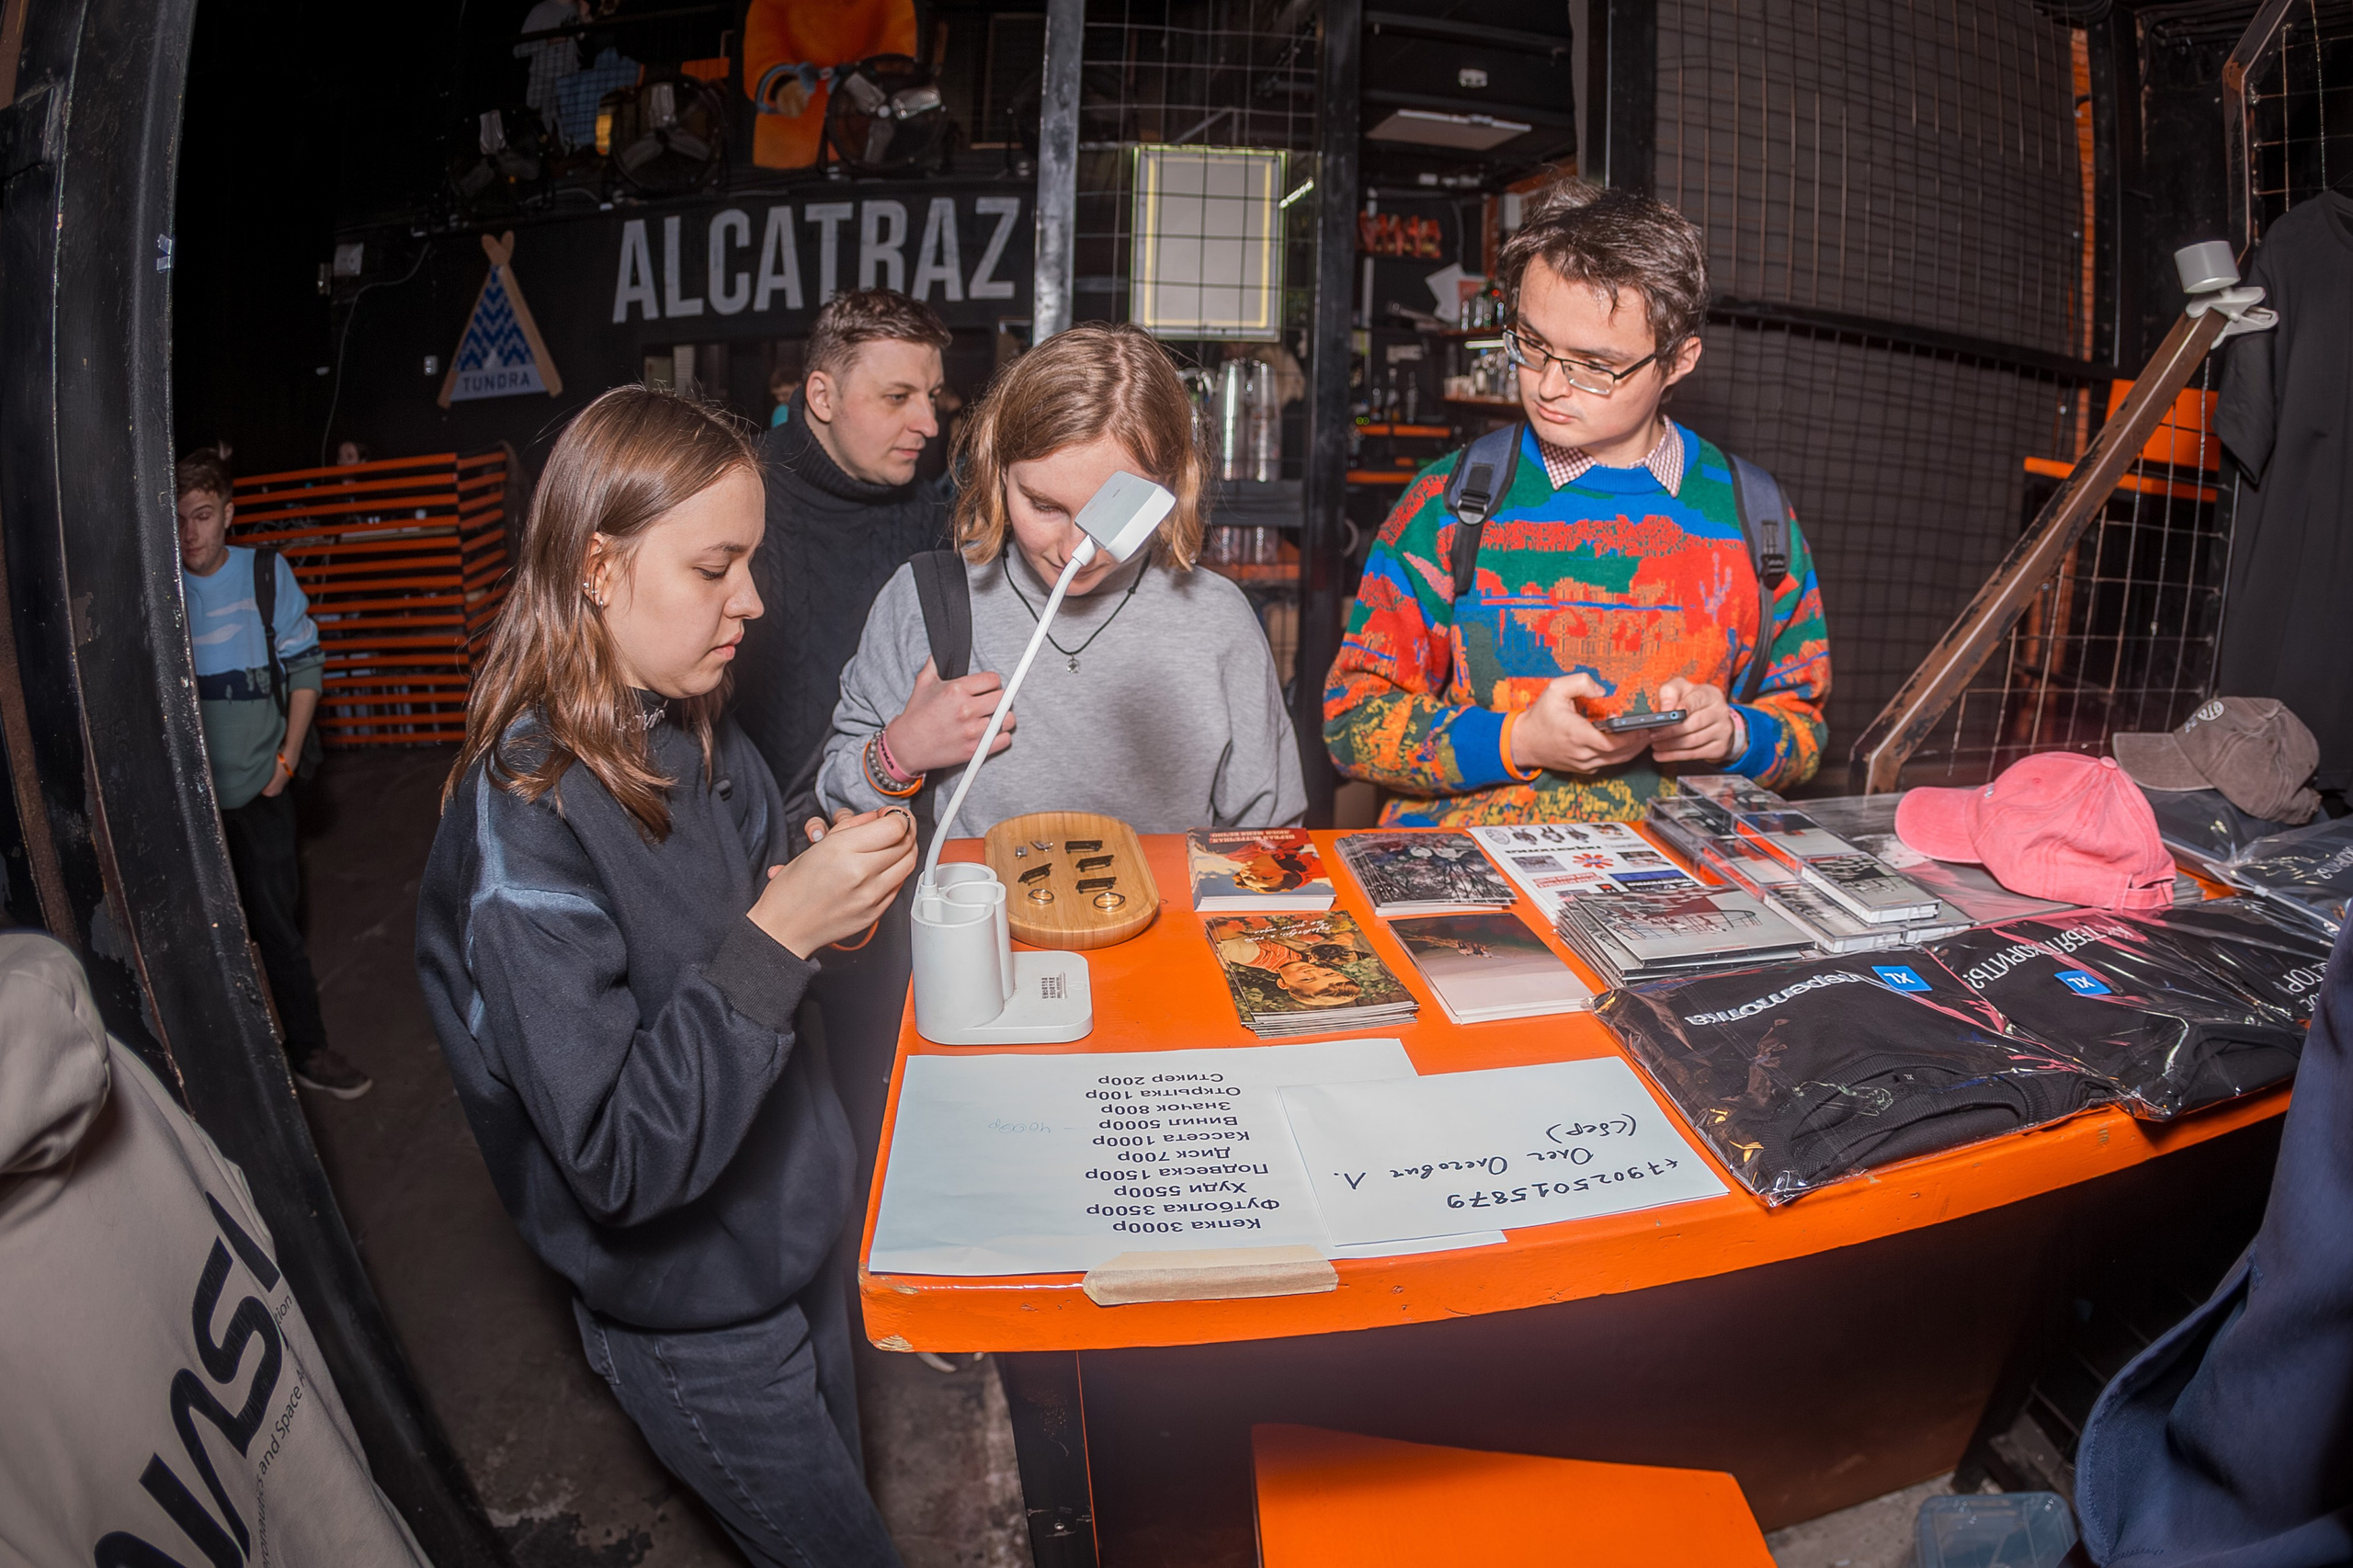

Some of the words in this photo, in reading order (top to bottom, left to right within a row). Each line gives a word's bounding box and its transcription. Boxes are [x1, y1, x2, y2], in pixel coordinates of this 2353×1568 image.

[612, 195, 1020, 324] ALCATRAZ
[462, 371, 530, 392] TUNDRA
[1883, 971, 1912, 985] XL
[2067, 976, 2097, 990] XL
[1098, 1076, 1144, 1085] 200р
[1152, 1074, 1223, 1082] Стикер
[1086, 1090, 1132, 1100] 100р
[1141, 1086, 1241, 1096] Открытка
[1101, 1104, 1149, 1115] 800р
[1156, 1102, 1231, 1111] Значок
[1099, 1119, 1160, 1131] 5000р
[1169, 1117, 1237, 1125] Винил
[1093, 1136, 1154, 1146] 1000р
[1164, 1131, 1249, 1142] Кассета
[1118, 1151, 1170, 1163] 700р
[1176, 1147, 1230, 1158] Диск
[1527, 1148, 1594, 1165] Олег
[1159, 1164, 1268, 1176] Подвеска
[1390, 1157, 1507, 1179] Олегович
[1086, 1168, 1150, 1181] 1500р
[1114, 1186, 1180, 1198] 5500р
[1189, 1181, 1246, 1193] Худи
[1086, 1204, 1155, 1216] 3500р
[1164, 1198, 1279, 1212] Футболка
[1113, 1221, 1183, 1233] 3000р
[1191, 1219, 1261, 1229] Кепка
[258, 1434, 280, 1475] and
[276, 1384, 304, 1440] Space
